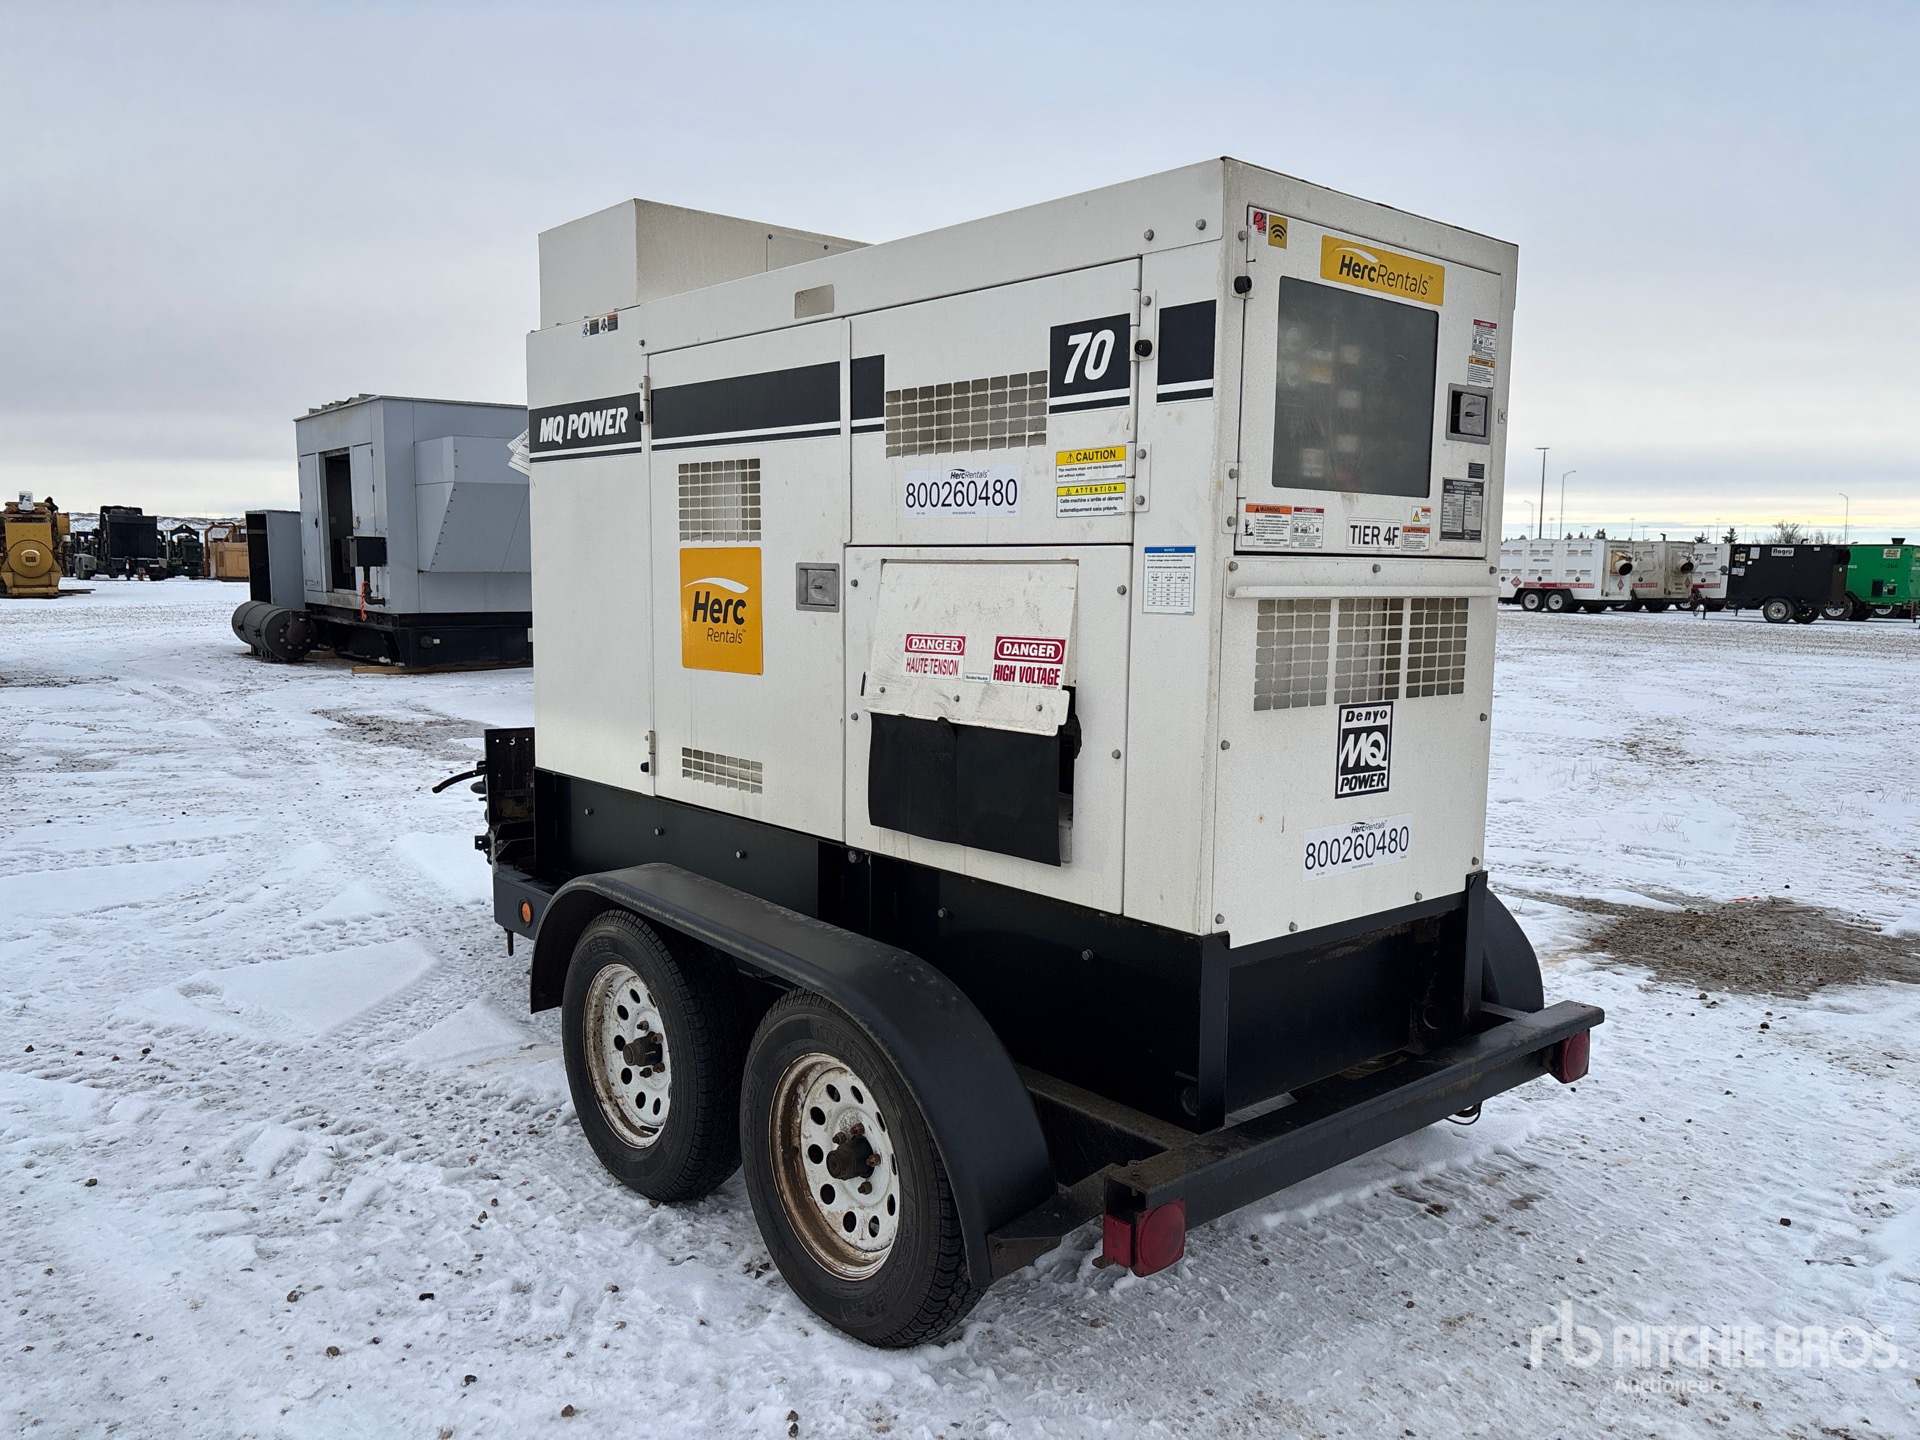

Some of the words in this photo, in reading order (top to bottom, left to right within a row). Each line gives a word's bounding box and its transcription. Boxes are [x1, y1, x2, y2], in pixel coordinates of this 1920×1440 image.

[1063, 329, 1116, 384] 70
[539, 415, 565, 445] MQ
[566, 406, 629, 440] POWER
[1075, 449, 1116, 462] CAUTION
[905, 478, 1018, 508] 800260480
[1075, 485, 1118, 494] ATTENTION
[1350, 525, 1380, 545] TIER
[1383, 526, 1400, 546] 4F
[692, 590, 747, 626] Herc
[911, 638, 959, 651] DANGER
[1003, 642, 1056, 657] DANGER
[905, 656, 928, 674] HAUTE
[929, 658, 960, 676] TENSION
[993, 663, 1017, 683] HIGH
[1018, 665, 1061, 686] VOLTAGE
[1344, 709, 1388, 725] Denyo
[1341, 730, 1387, 769] MQ
[1340, 772, 1386, 791] POWER
[1304, 825, 1410, 870] 800260480
